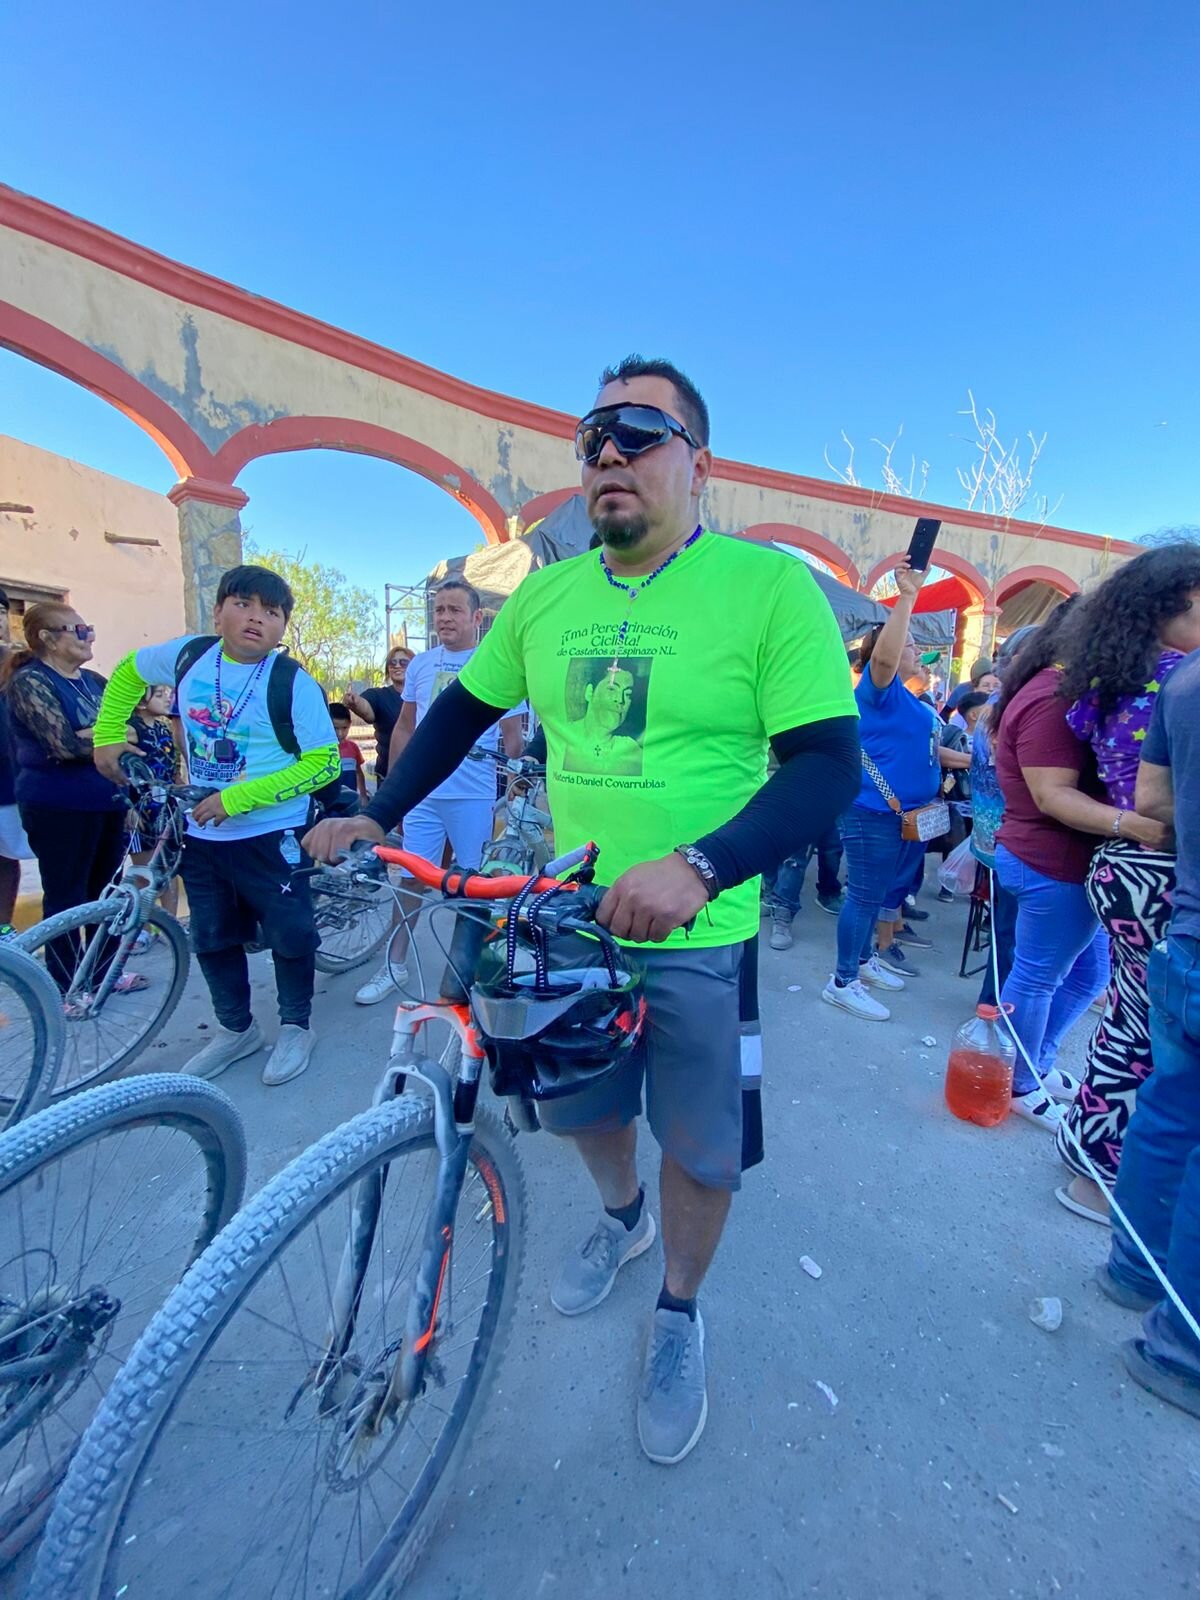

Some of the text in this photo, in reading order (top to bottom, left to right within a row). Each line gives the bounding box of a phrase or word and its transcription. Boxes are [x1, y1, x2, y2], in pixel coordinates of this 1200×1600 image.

[590, 634, 642, 647] Ciclista!
[556, 648, 568, 657] de
[568, 646, 609, 656] Castaños
[617, 646, 658, 658] Espinazo
[576, 776, 603, 787] Daniel
[605, 778, 666, 789] Covarrubias
